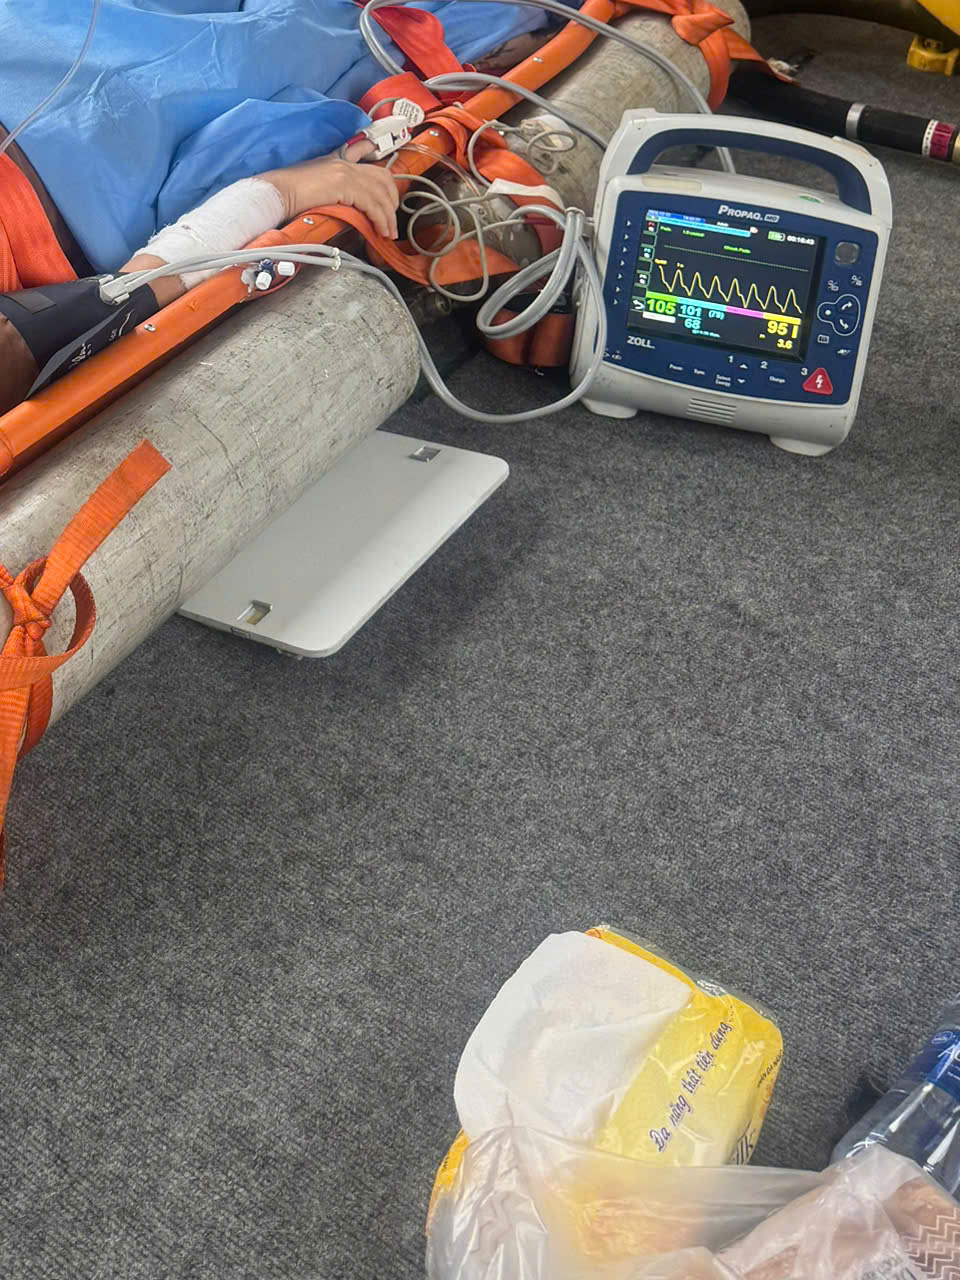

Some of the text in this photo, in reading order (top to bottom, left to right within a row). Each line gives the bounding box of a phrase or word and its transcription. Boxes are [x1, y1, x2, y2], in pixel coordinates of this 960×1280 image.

[646, 298, 676, 315] 105
[680, 304, 702, 317] 101
[684, 318, 701, 330] 68
[767, 320, 788, 336] 95
[776, 338, 793, 350] 3.6
[728, 355, 734, 363] 1
[760, 361, 768, 369] 2
[800, 367, 808, 376] 3
[649, 1126, 671, 1152] Đa
[669, 1094, 693, 1127] năng
[682, 1067, 705, 1094] thật
